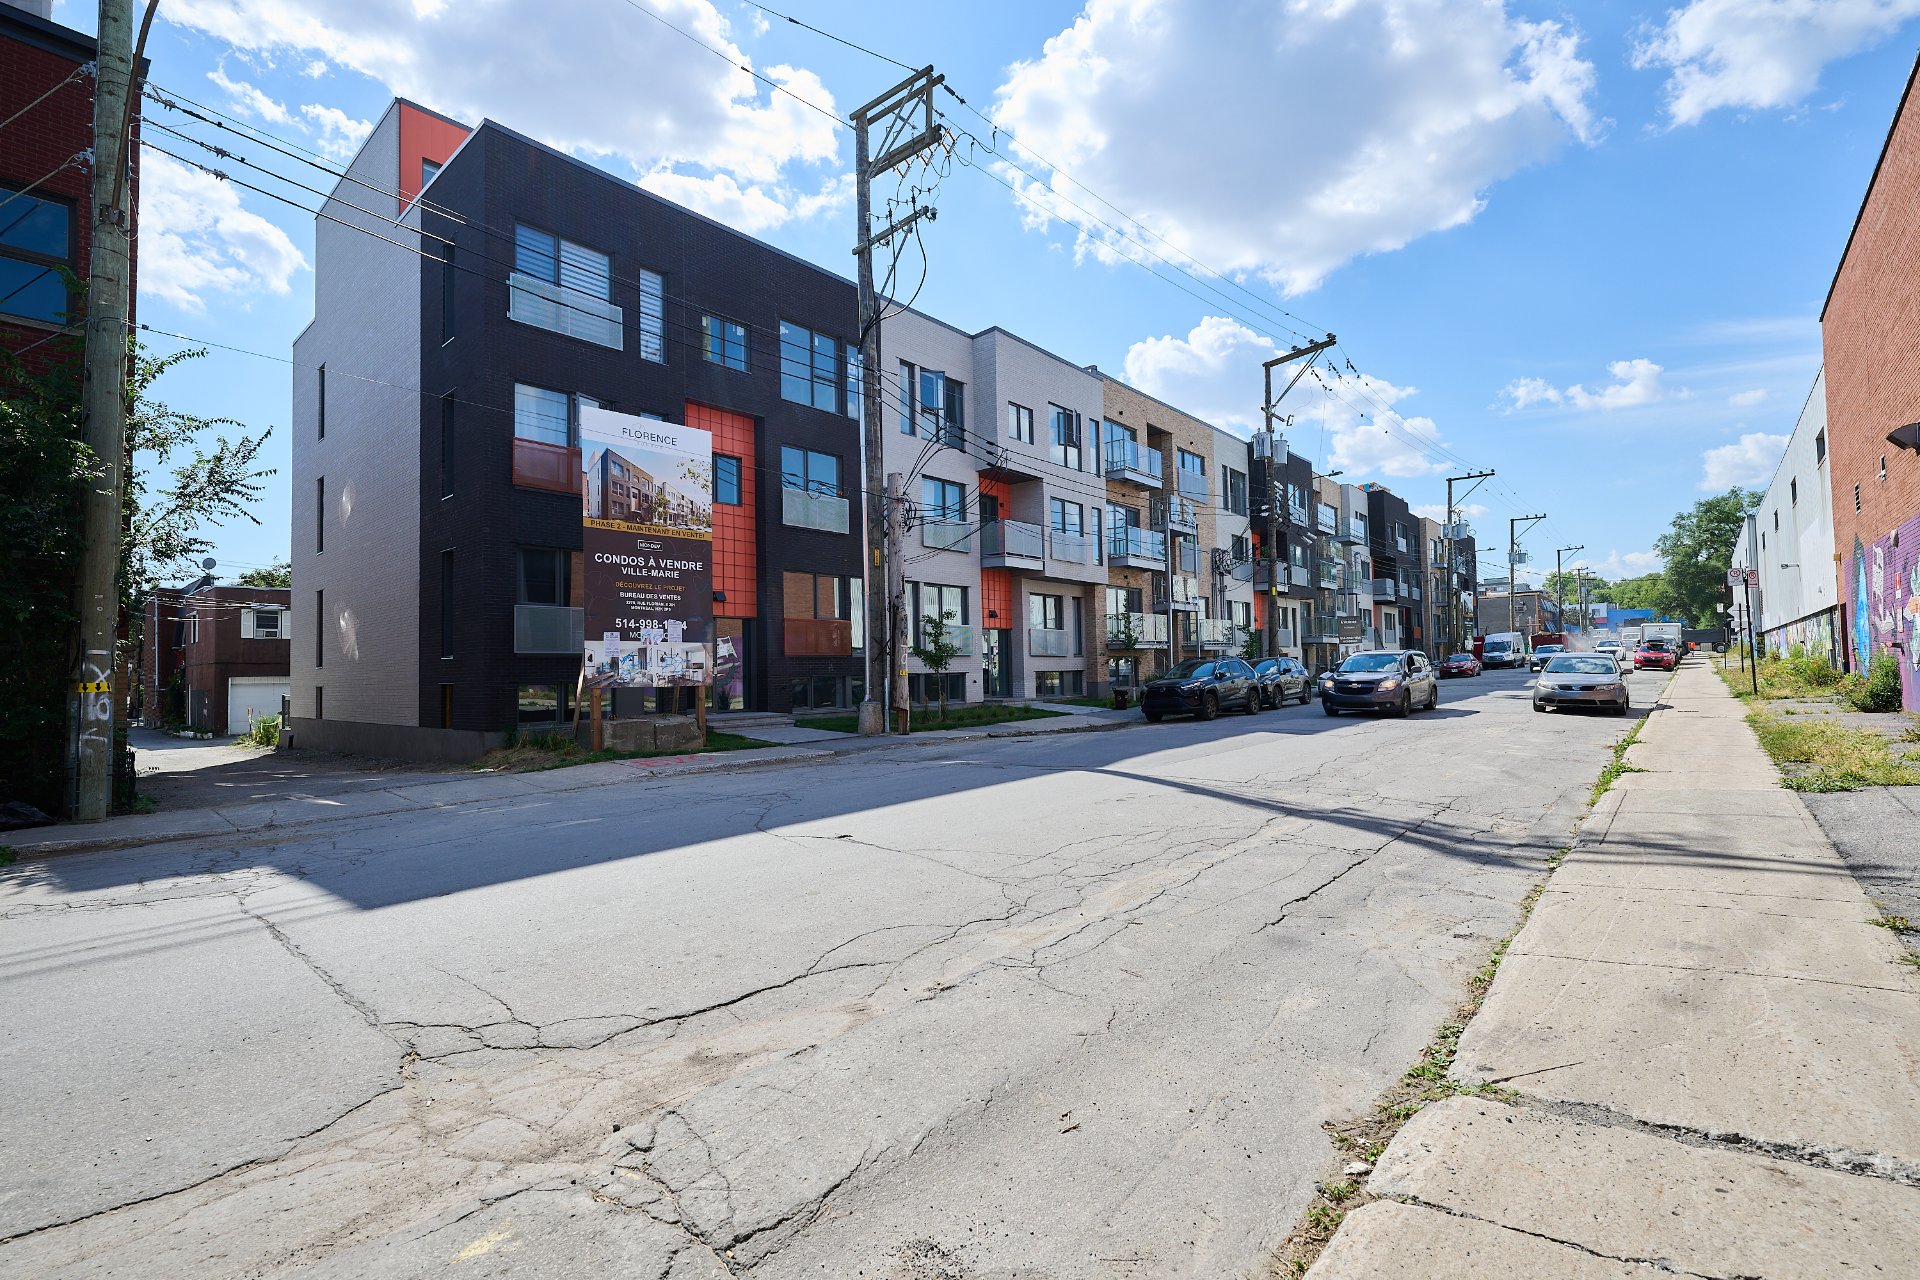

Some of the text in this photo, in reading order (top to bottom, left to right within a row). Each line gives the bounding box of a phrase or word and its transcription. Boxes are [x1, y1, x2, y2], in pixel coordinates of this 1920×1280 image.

[622, 427, 678, 446] FLORENCE
[590, 519, 615, 529] PHASE
[626, 524, 670, 536] MAINTENANT
[594, 553, 703, 571] CONDOS À VENDRE
[621, 566, 680, 579] VILLE-MARIE
[615, 580, 653, 590] DÉCOUVREZ
[663, 584, 686, 592] PROJET
[619, 591, 645, 600] BUREAU
[615, 618, 688, 630] 514-998-14
